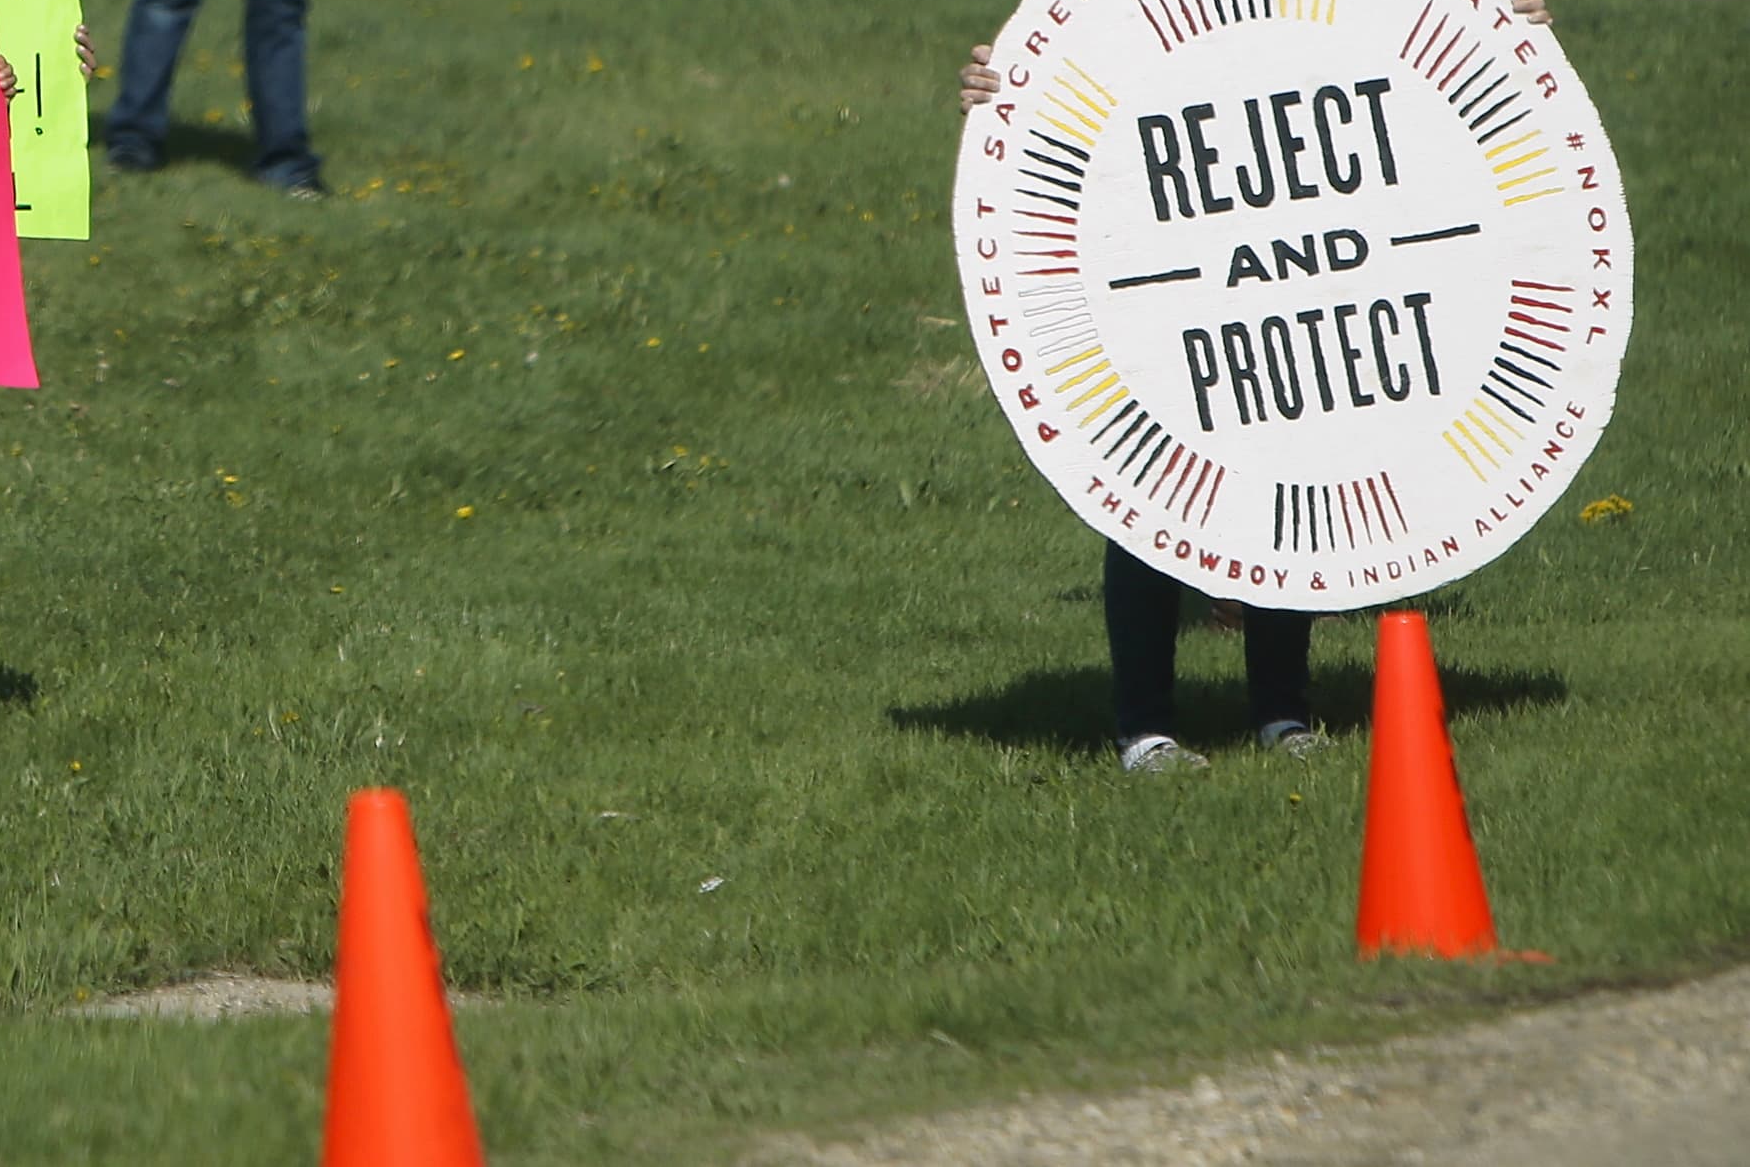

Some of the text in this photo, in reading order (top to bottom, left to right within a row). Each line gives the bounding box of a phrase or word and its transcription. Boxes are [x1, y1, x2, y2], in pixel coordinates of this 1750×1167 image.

[1137, 78, 1400, 223] REJECT
[977, 197, 1061, 443] PROTECT
[1565, 131, 1613, 344] #NOKXL
[1226, 228, 1370, 288] AND
[1182, 293, 1441, 433] PROTECT
[1085, 400, 1586, 591] THE COWBOY & INDIAN ALLIANCE
